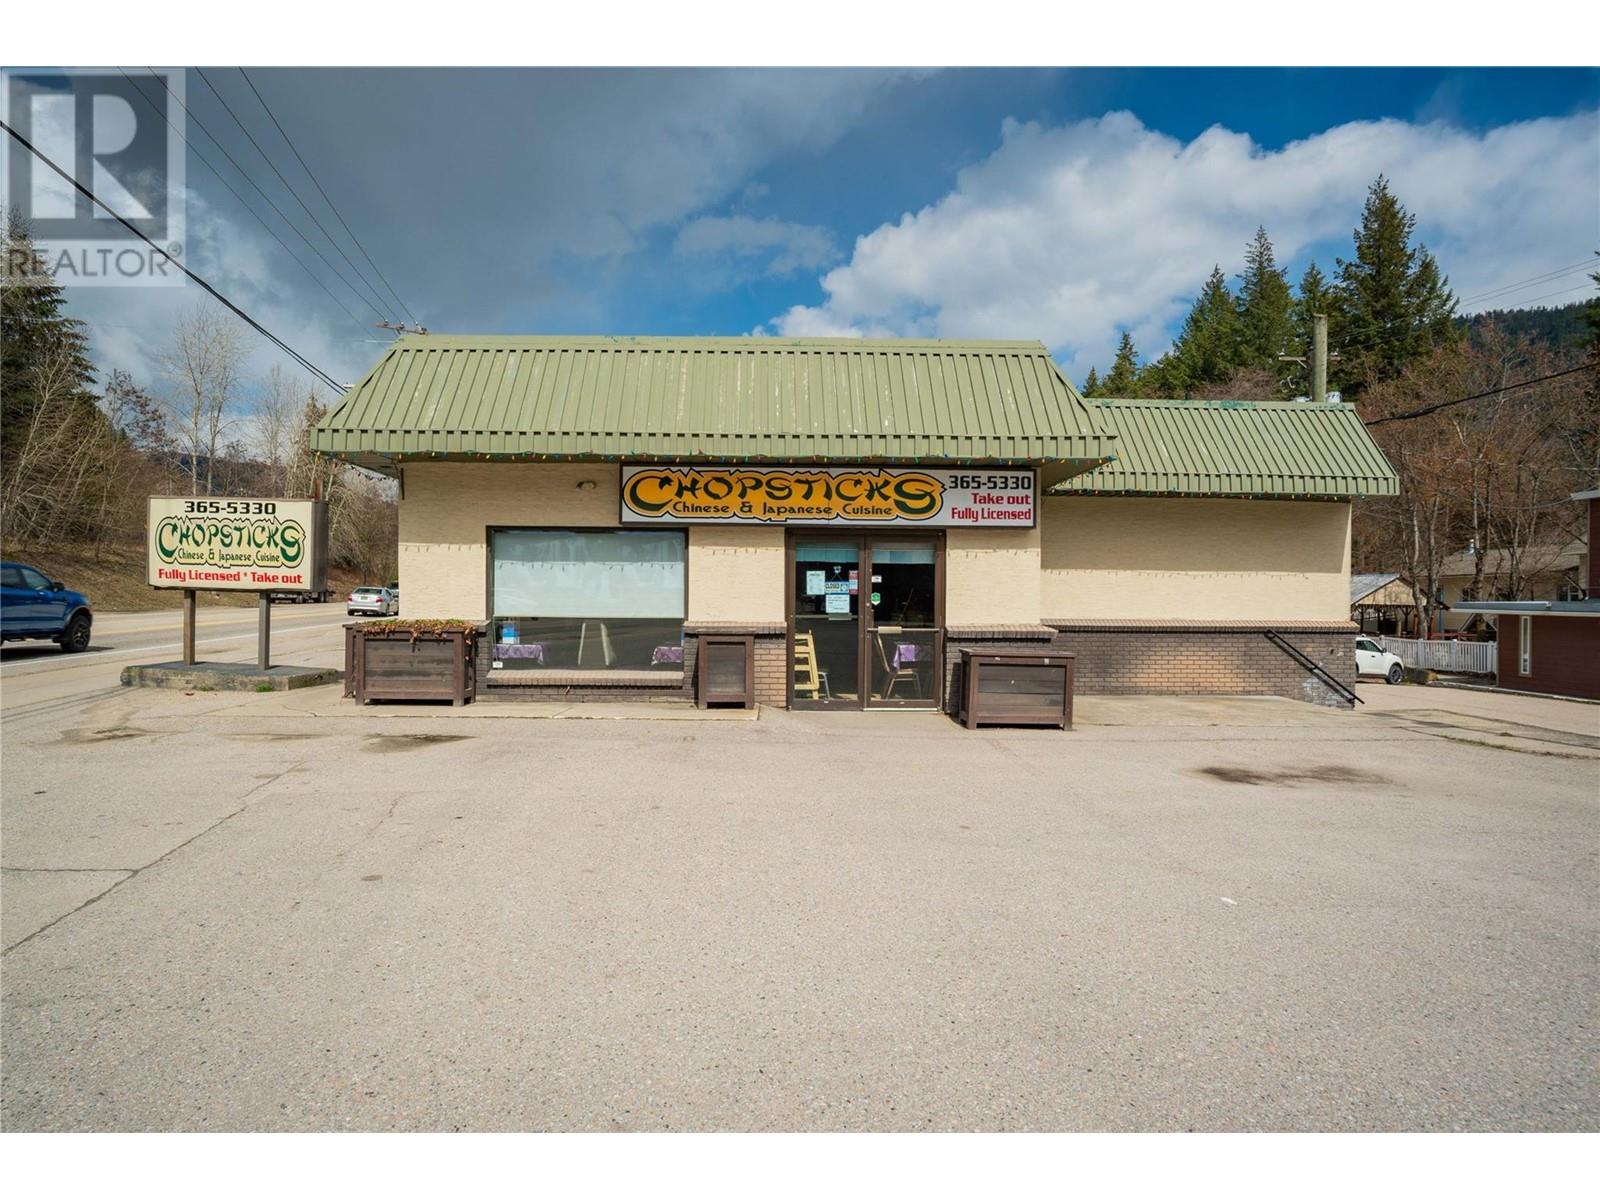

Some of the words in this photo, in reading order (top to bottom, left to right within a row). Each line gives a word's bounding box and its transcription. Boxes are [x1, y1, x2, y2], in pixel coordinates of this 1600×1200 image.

[948, 475, 1032, 490] 365-5330
[629, 475, 936, 514] CHOPSTICKS
[971, 492, 1004, 505] Take
[1007, 494, 1032, 505] out
[184, 501, 276, 515] 365-5330
[672, 501, 730, 513] Chinese
[739, 502, 753, 513] &
[762, 502, 833, 516] Japanese
[842, 503, 892, 515] Cuisine
[951, 507, 979, 522] Fully
[981, 507, 1032, 520] Licensed
[158, 522, 301, 562] CHOPSTICKS
[177, 548, 205, 560] Chinese
[208, 548, 215, 560] &
[218, 549, 252, 563] Japanese
[255, 551, 280, 562] Cuisine
[158, 568, 187, 582] Fully
[188, 569, 241, 582] Licensed
[250, 572, 279, 583] Take
[281, 574, 303, 584] out
